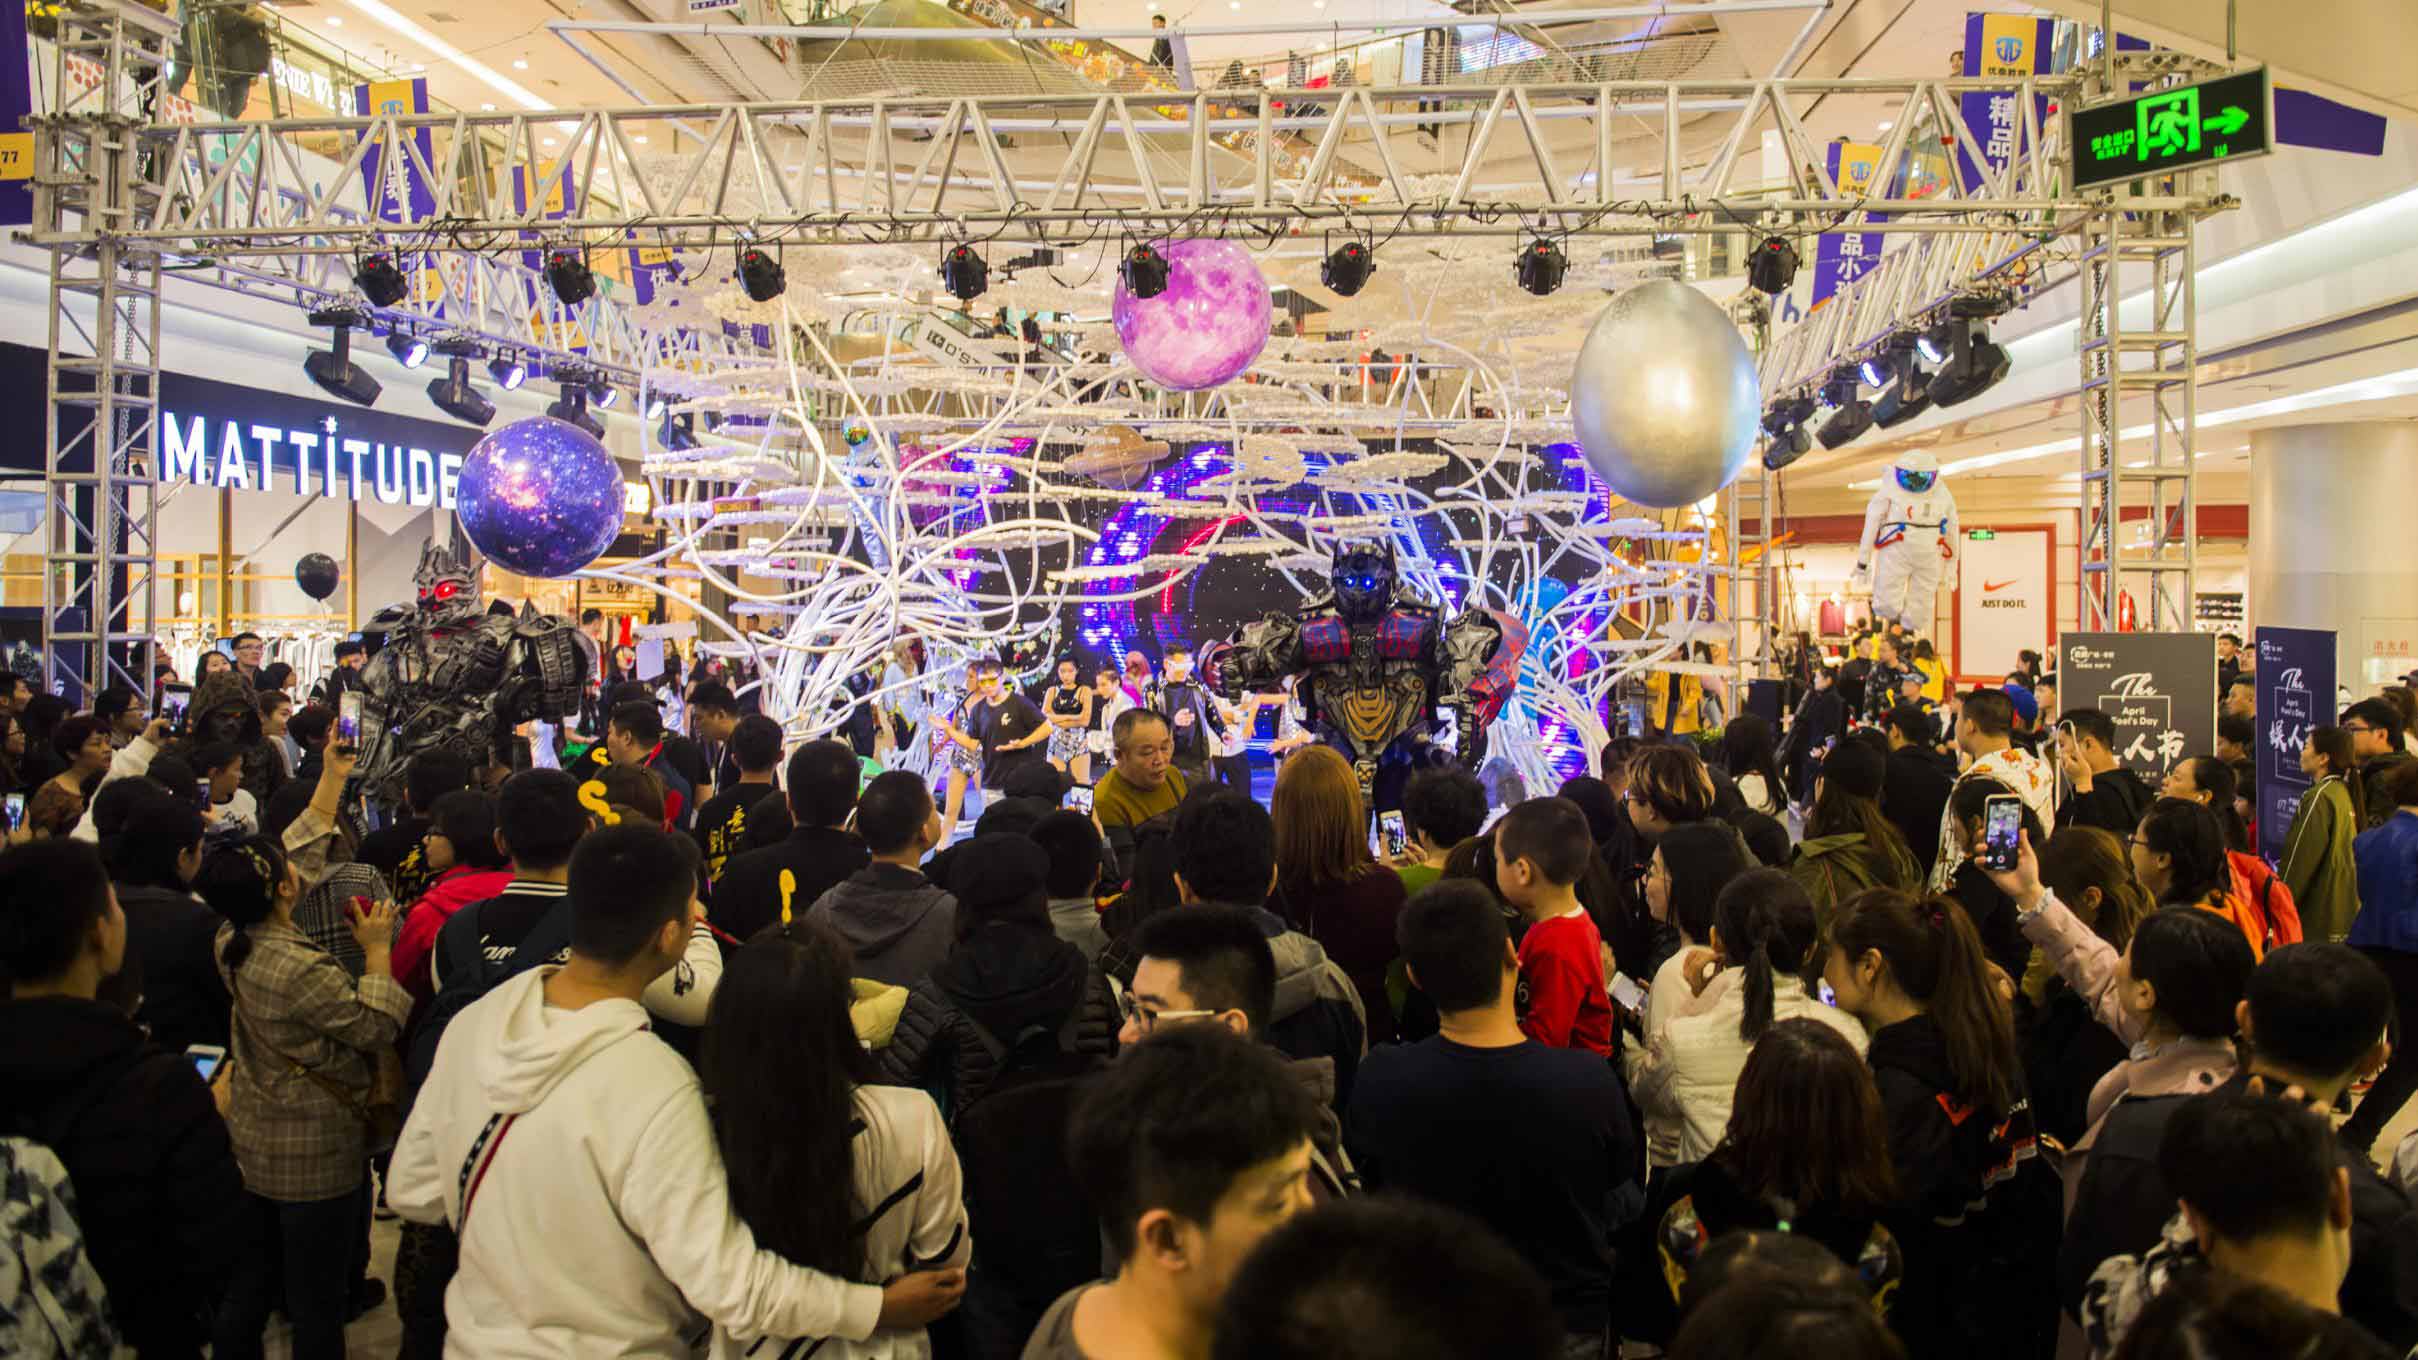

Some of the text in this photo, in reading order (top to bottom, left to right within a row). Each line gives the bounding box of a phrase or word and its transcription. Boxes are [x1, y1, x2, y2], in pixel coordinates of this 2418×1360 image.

[2096, 144, 2130, 160] EXIT
[1981, 599, 2000, 608] JUST
[2002, 599, 2016, 608] DO
[2111, 672, 2158, 703] The
[2280, 667, 2305, 695] The
[2122, 706, 2145, 716] April
[2139, 716, 2159, 728] Day
